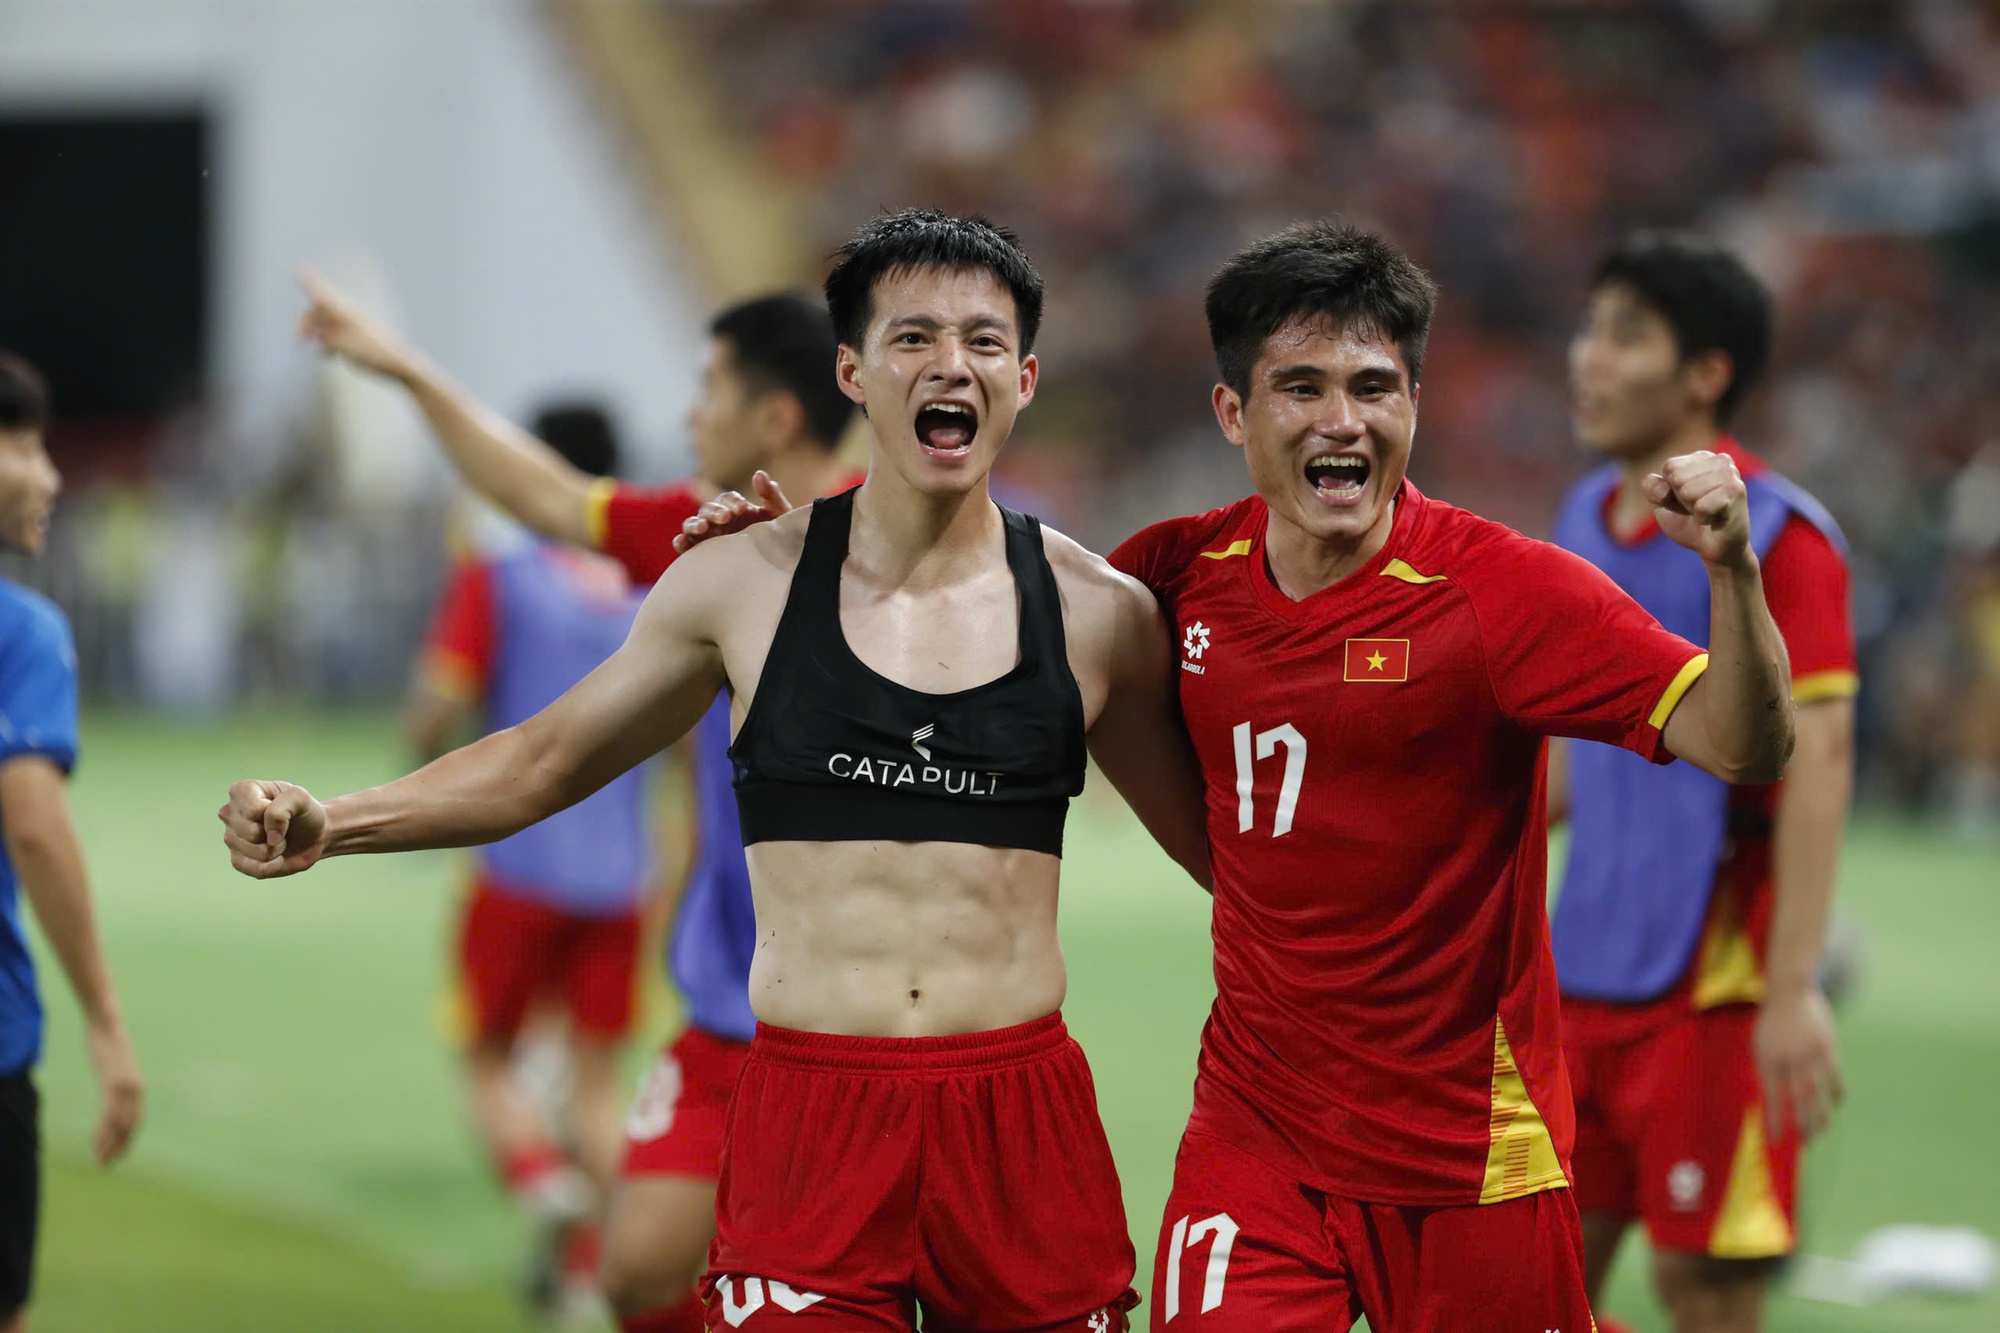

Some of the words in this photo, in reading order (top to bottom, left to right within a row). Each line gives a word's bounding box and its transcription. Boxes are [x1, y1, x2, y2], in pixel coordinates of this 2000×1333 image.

[828, 753, 1004, 795] CATAPULT
[1232, 720, 1308, 838] 17
[1165, 1211, 1241, 1325] 17
